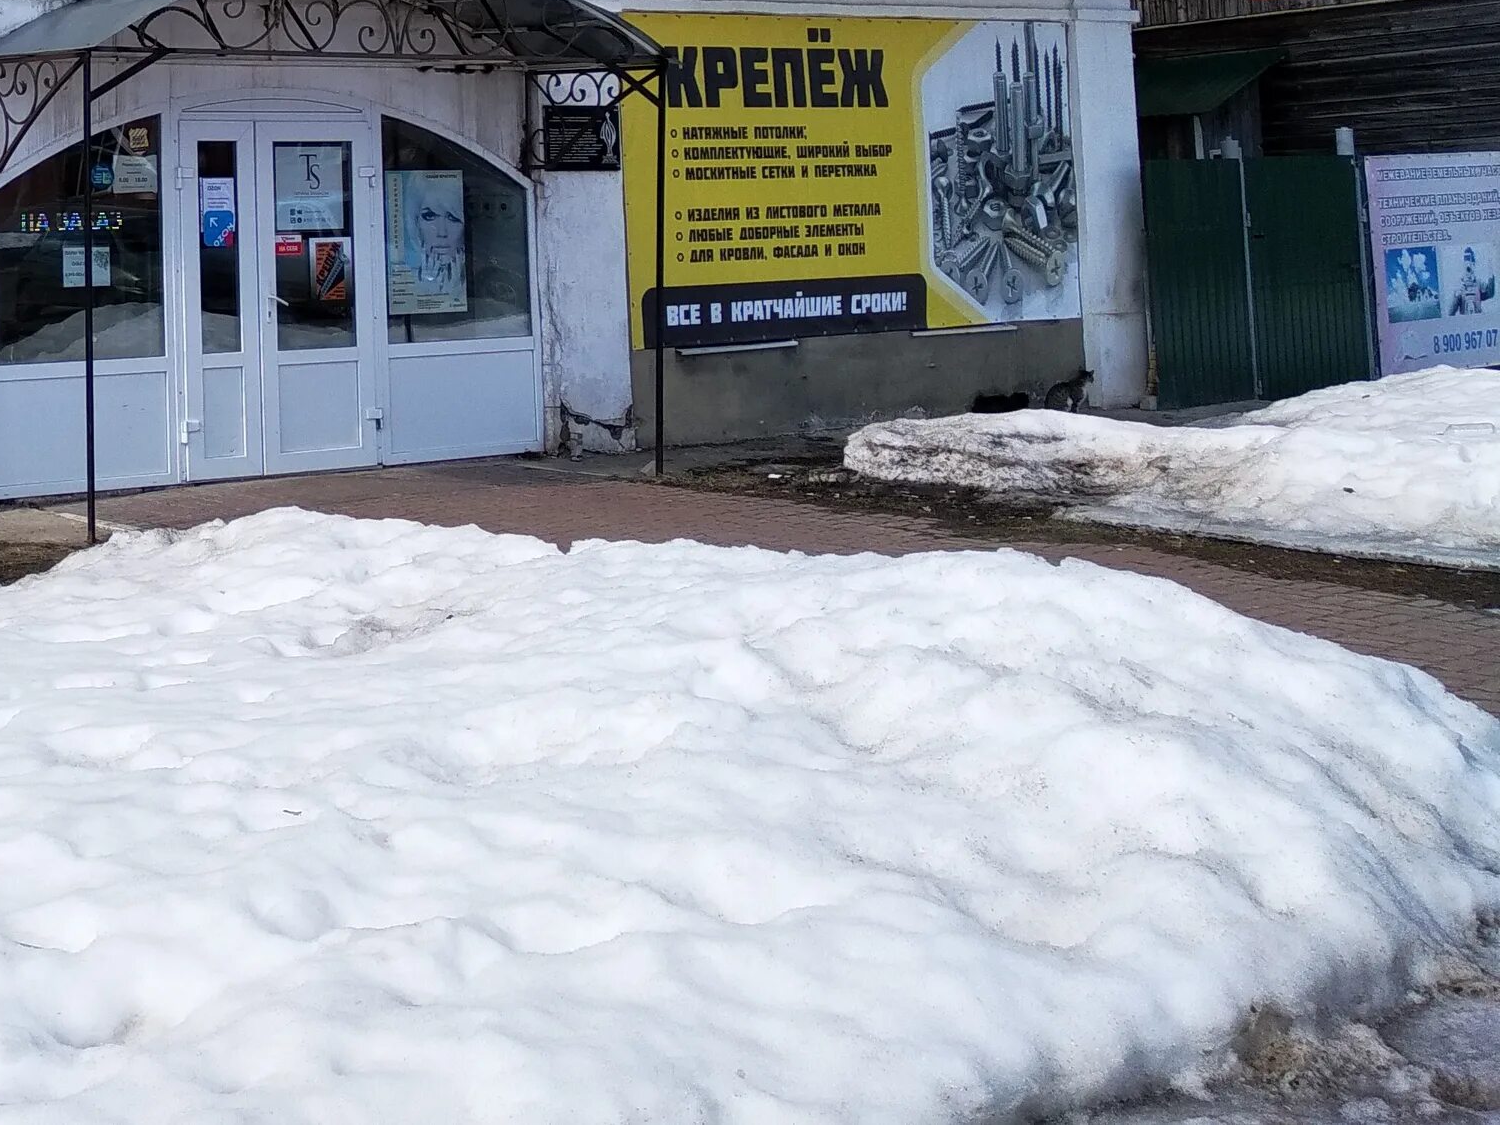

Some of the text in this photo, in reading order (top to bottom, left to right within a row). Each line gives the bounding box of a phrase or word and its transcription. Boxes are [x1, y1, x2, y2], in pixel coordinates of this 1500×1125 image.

[665, 28, 889, 108] КРЕПЁЖ
[682, 127, 748, 140] НАТЯЖНЫЕ
[684, 142, 892, 160] КОМПЛЕКТУЮЩИЕ, ШИРОКИЙ ВЫБОР
[685, 163, 877, 181] МОСКИТНЫЕ СЕТКИ И ПЕРЕТЯЖКА
[1379, 195, 1436, 209] ТЕХНИЧЕСКИЕ
[1437, 193, 1466, 205] ПЛАНЫ
[687, 203, 881, 222] ИЗДЕЛИЯ ИЗ ЛИСТОВОГО МЕТАЛЛА
[1439, 209, 1482, 223] ОБЪЕКТОВ
[688, 223, 864, 242] ЛЮБЫЕ ДОБОРНЫЕ ЭЛЕМЕНТЫ
[690, 243, 866, 263] ДЛЯ КРОВЛИ, ФАСАДА И ОКОН
[666, 291, 907, 326] ВСЕ В КРАТЧАЙШИЕ СРОКИ!
[1433, 329, 1498, 354] 8 900 967 07
